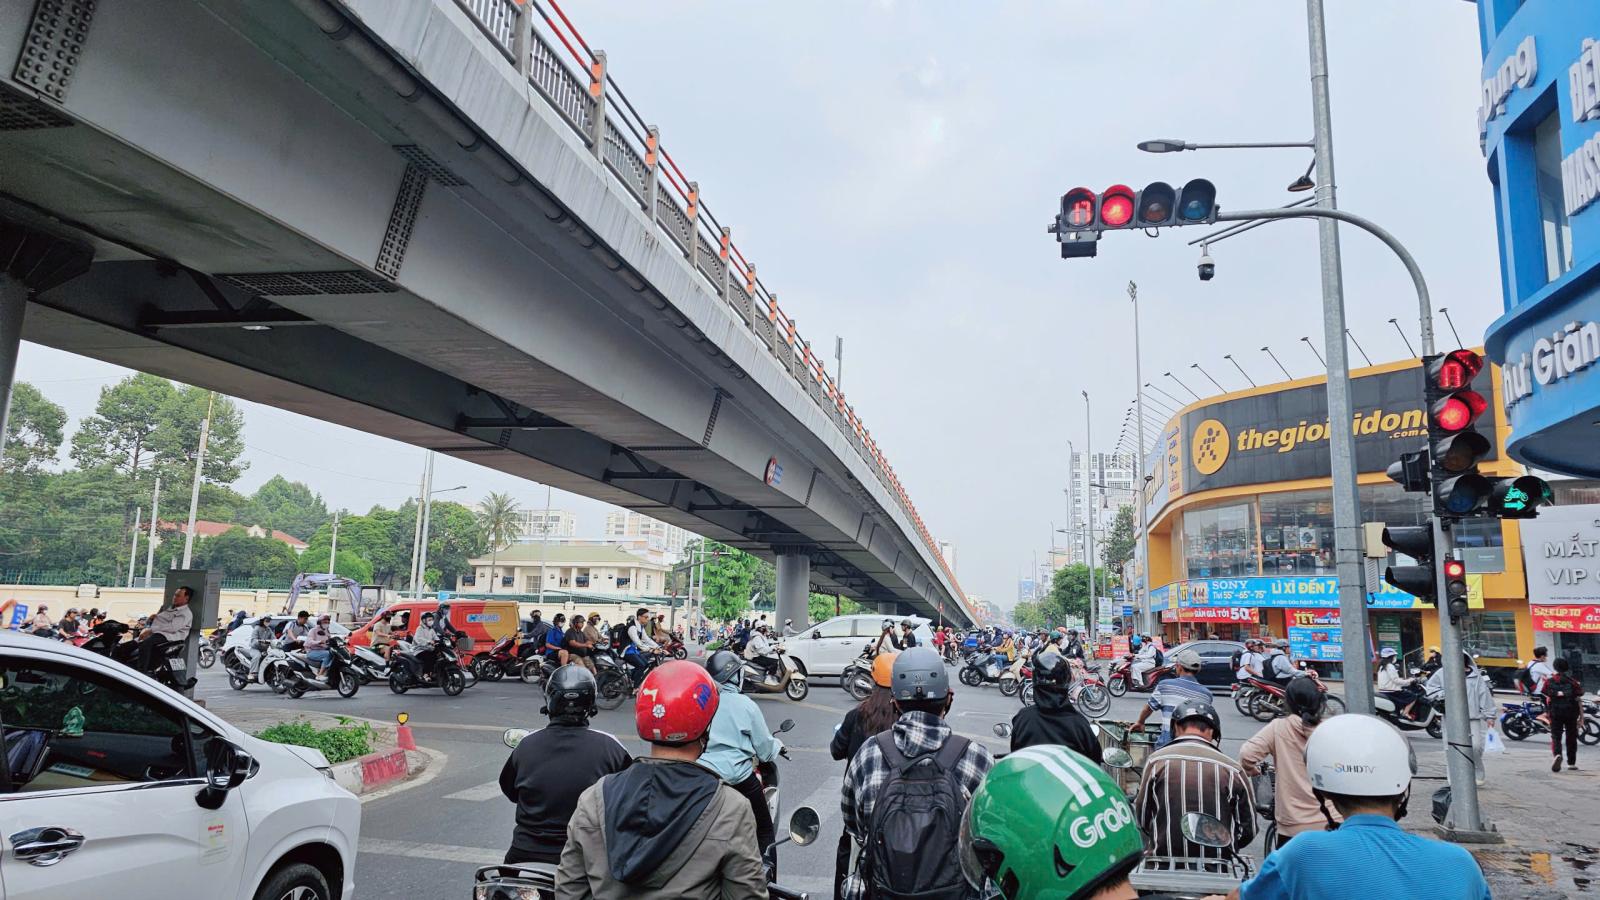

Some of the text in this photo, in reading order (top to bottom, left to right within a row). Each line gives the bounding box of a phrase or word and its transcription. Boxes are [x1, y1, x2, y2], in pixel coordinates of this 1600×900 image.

[1544, 531, 1599, 558] MẮT
[1212, 580, 1248, 590] SONY
[1545, 567, 1588, 585] VIP
[1069, 796, 1131, 848] Grab
